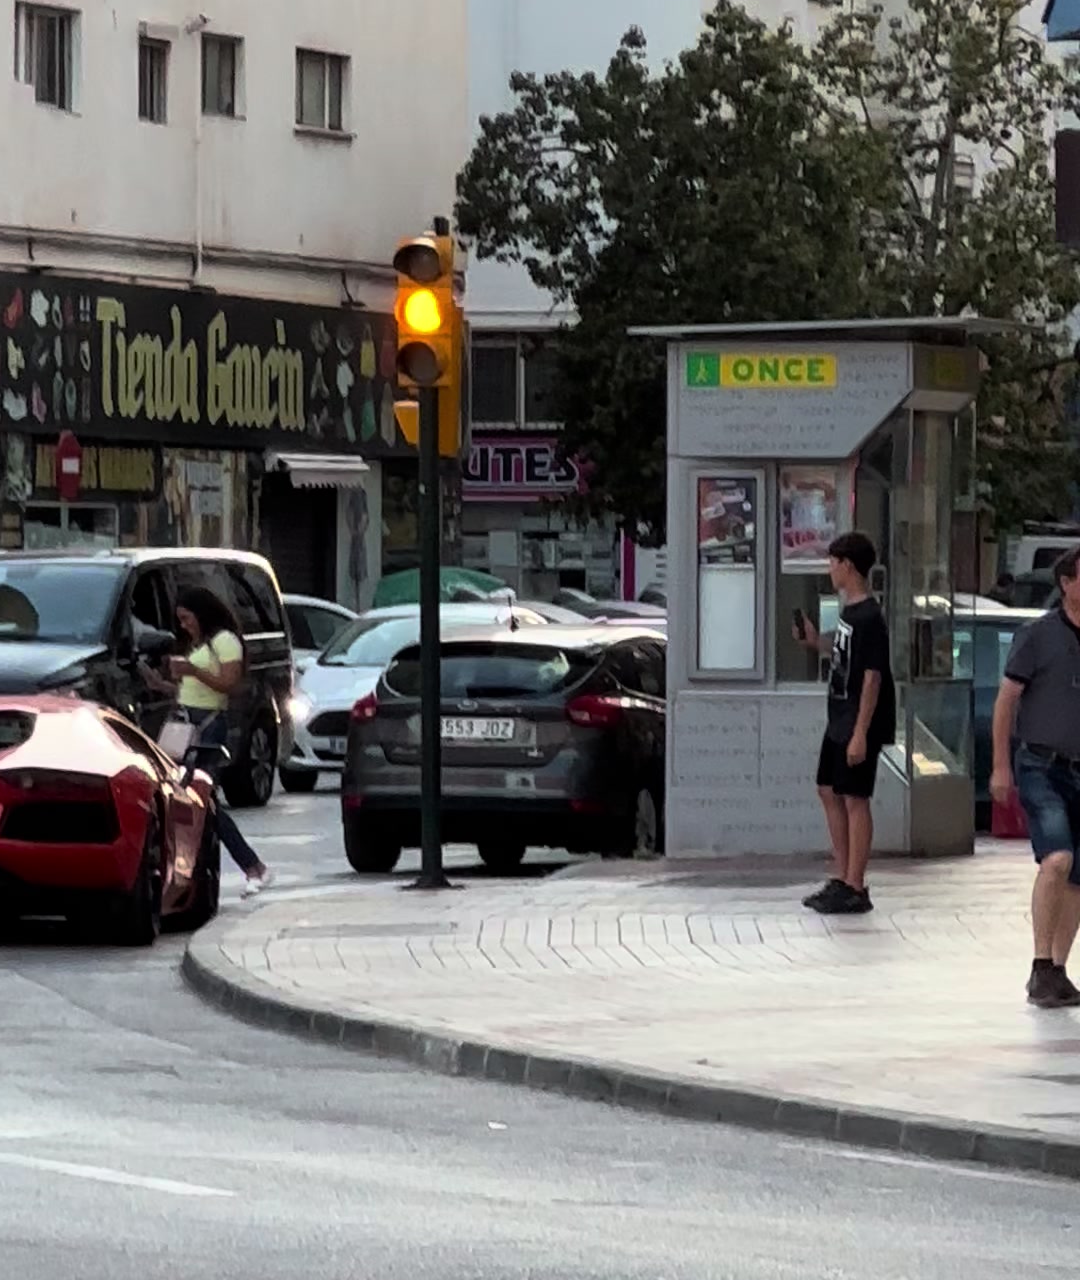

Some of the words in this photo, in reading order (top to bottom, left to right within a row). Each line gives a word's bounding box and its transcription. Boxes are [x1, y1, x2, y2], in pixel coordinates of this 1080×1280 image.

[96, 296, 200, 423] Tienda
[732, 358, 825, 383] ONCE
[441, 720, 474, 736] 553
